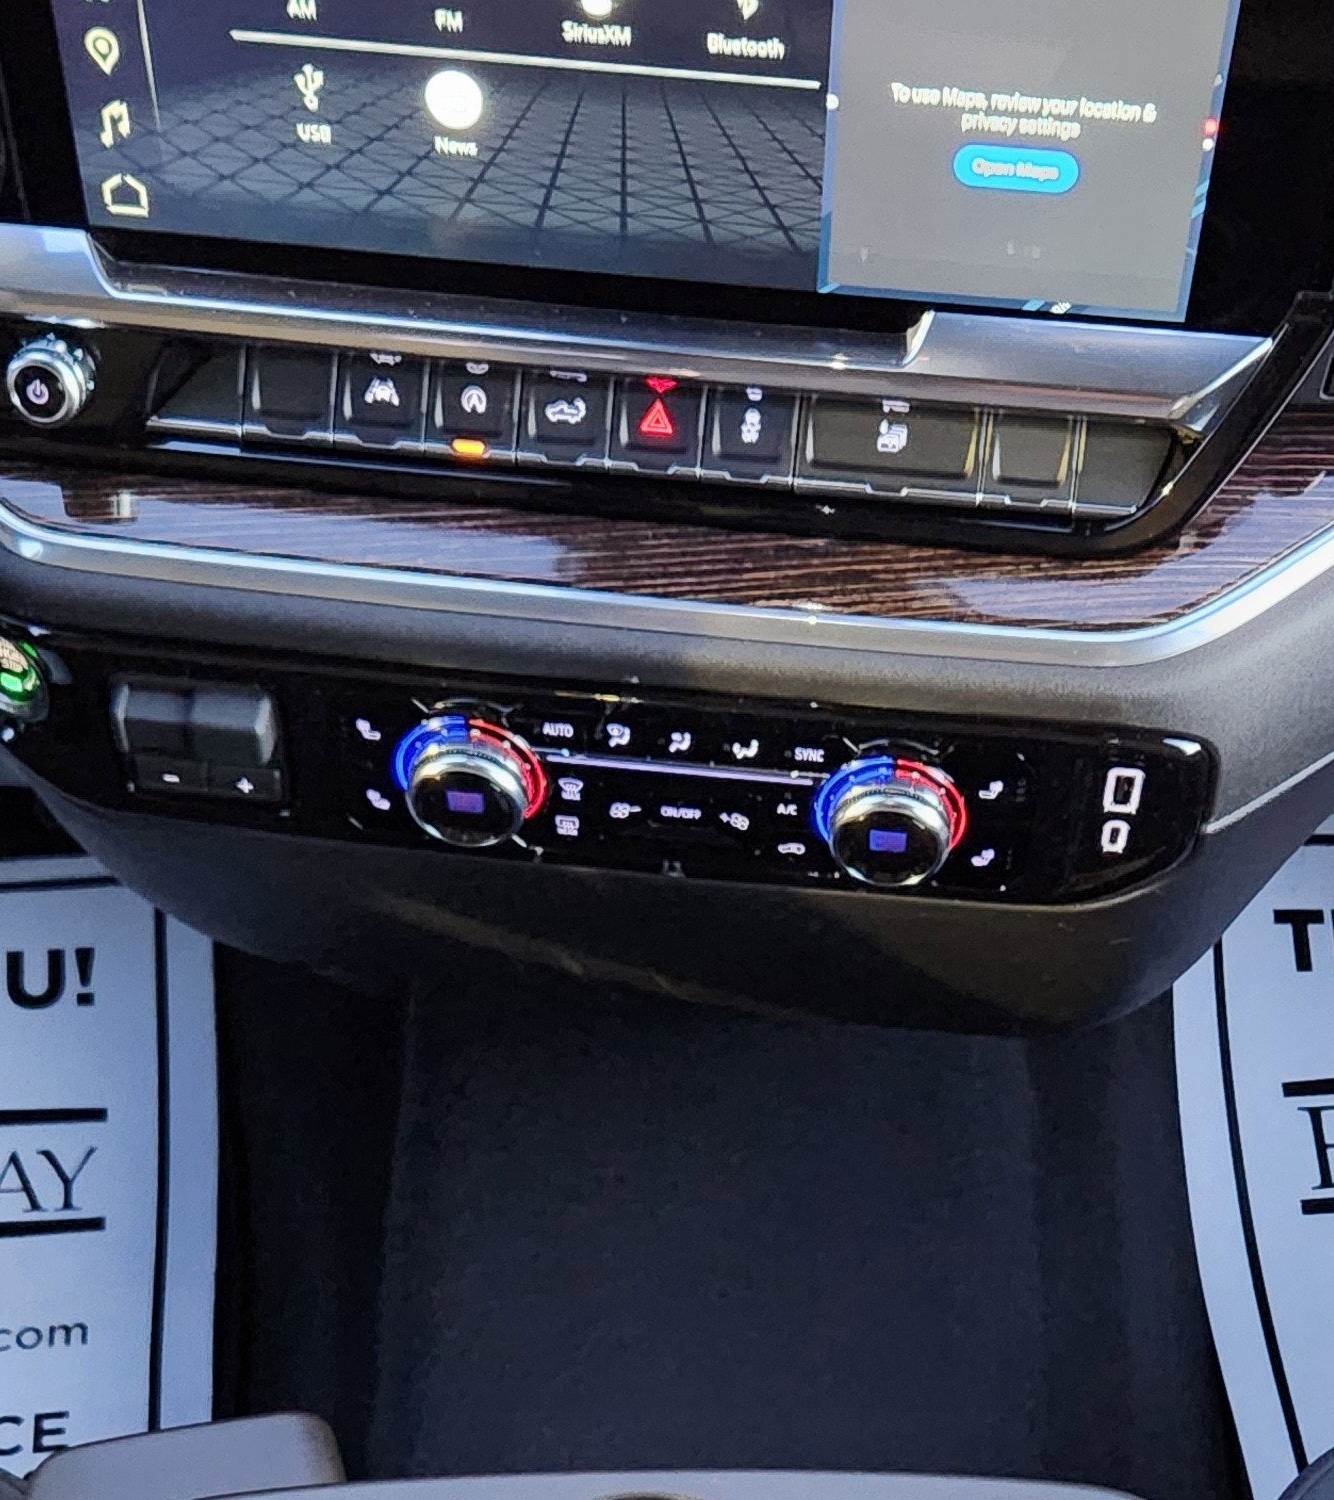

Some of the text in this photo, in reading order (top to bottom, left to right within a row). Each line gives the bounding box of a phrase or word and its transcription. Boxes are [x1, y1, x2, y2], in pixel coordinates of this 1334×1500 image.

[287, 0, 317, 20] AM
[434, 7, 463, 33] FM
[561, 19, 632, 47] SiriusXM
[706, 32, 785, 61] Bluetooth
[891, 82, 1157, 124] To use Maps, review your location &
[296, 122, 332, 144] USB
[961, 111, 1081, 142] privacy settings
[434, 135, 478, 157] News
[972, 157, 1059, 182] Open Maps
[542, 721, 574, 739] AUTO
[794, 746, 825, 764] SYNC
[660, 804, 703, 822] ON/OFF
[776, 802, 798, 818] A/C
